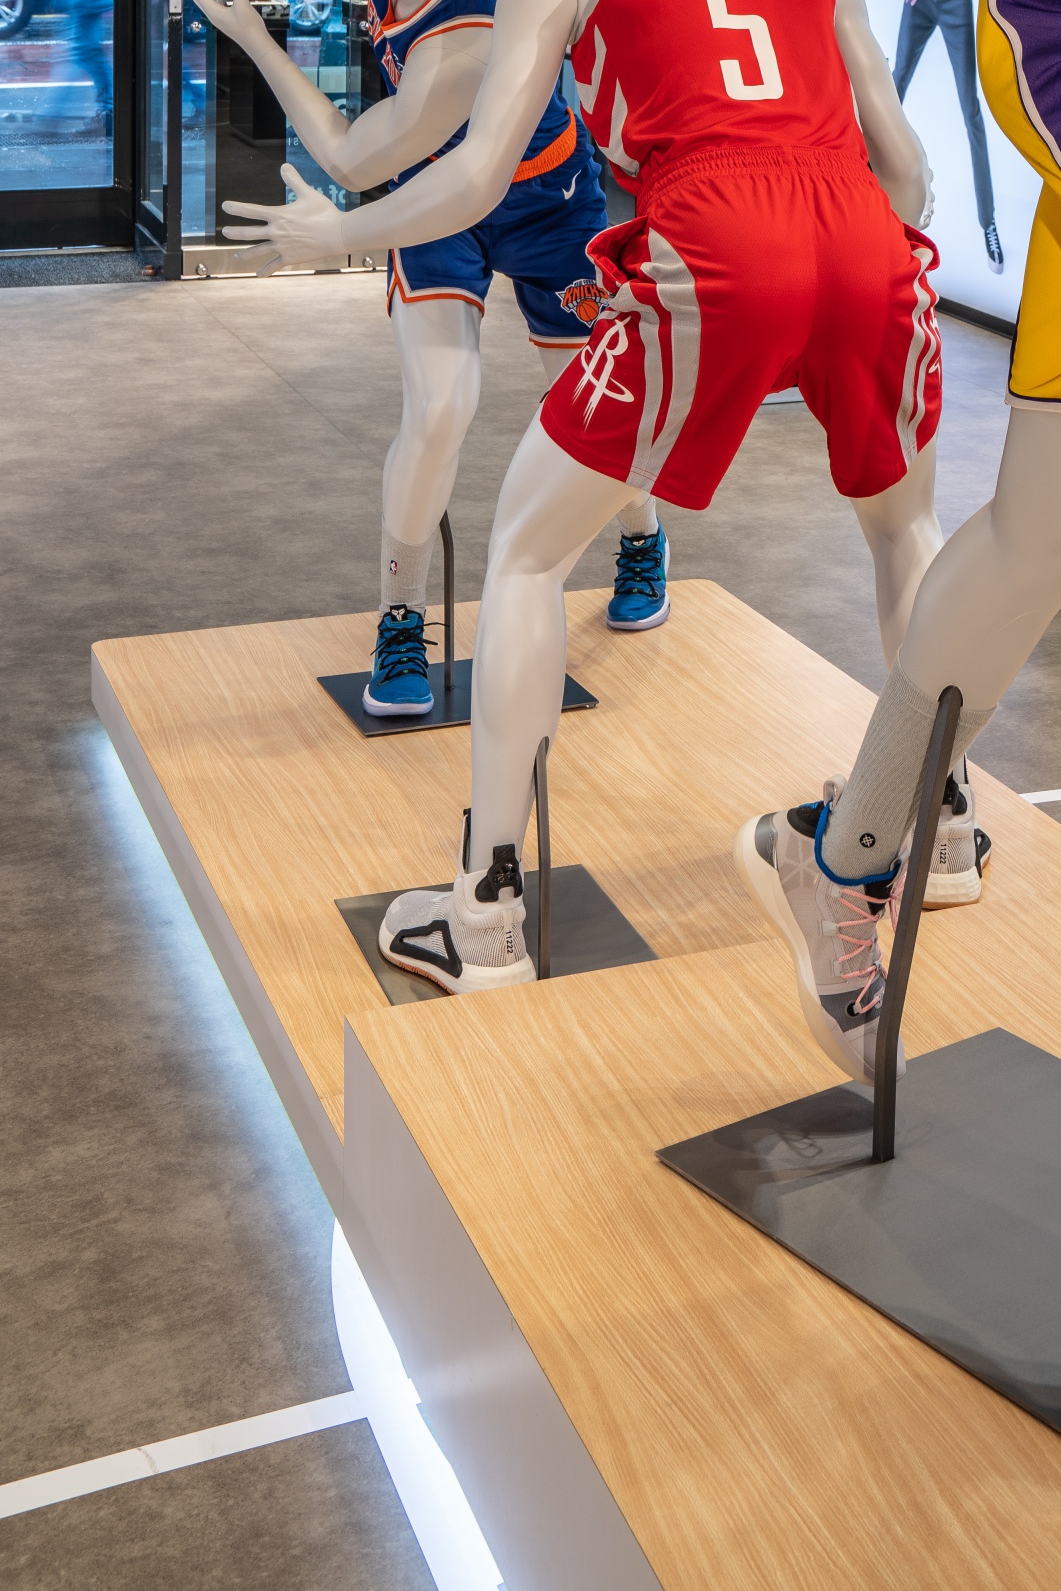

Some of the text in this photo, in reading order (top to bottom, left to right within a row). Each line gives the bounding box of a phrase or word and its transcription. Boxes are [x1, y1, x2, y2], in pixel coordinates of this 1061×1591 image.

[562, 284, 609, 307] KNICKS
[939, 843, 947, 865] 11222
[505, 929, 514, 954] 11222
